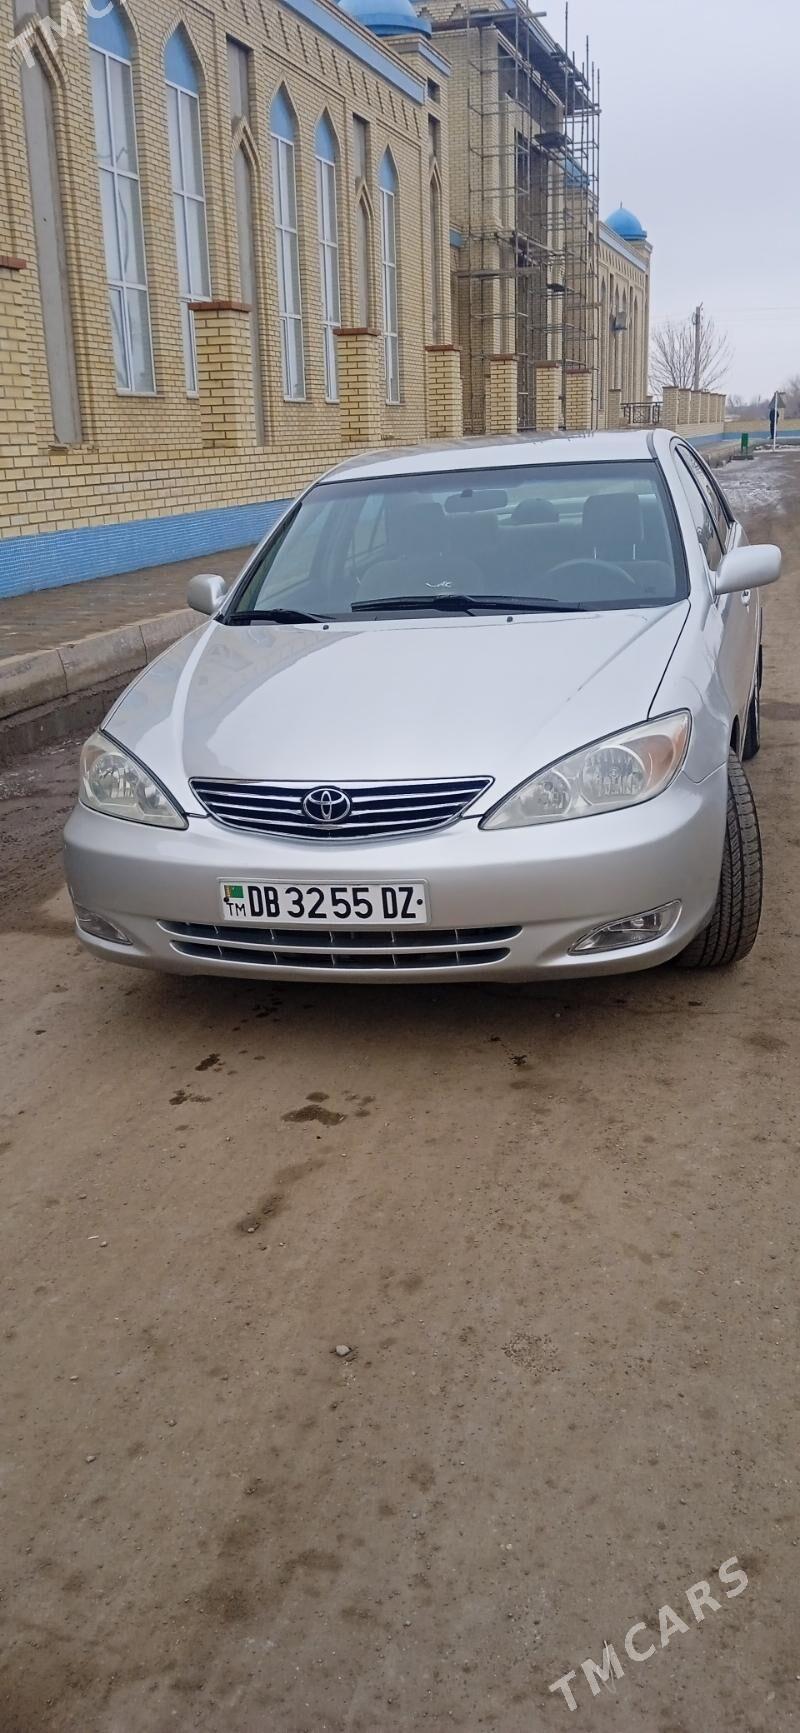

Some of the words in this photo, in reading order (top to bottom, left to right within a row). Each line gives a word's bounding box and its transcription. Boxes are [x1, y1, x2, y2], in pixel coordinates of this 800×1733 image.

[226, 902, 247, 917] TM
[247, 885, 280, 918] DB
[381, 886, 416, 919] DZ
